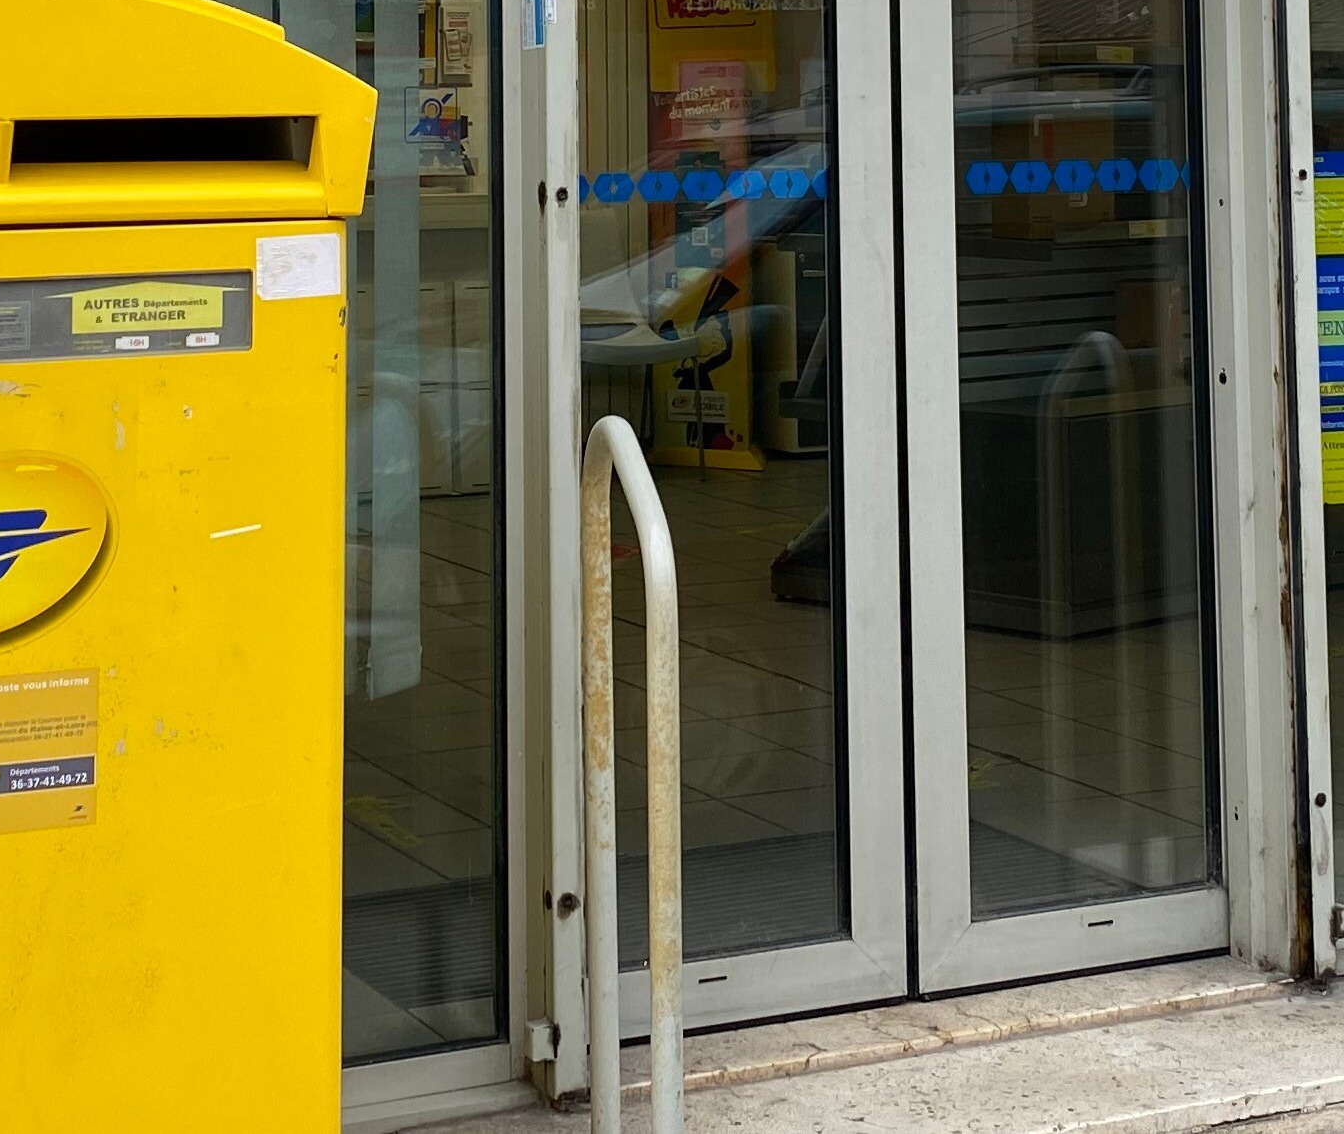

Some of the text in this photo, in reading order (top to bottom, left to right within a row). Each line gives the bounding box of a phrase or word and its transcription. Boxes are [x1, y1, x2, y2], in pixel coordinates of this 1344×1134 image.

[84, 298, 208, 310] AUTRES Départements
[95, 310, 186, 324] & ETRANGER
[23, 681, 47, 690] vous
[49, 676, 89, 687] informe
[10, 764, 59, 777] Départements
[11, 773, 88, 790] 36-37-41-49-72
